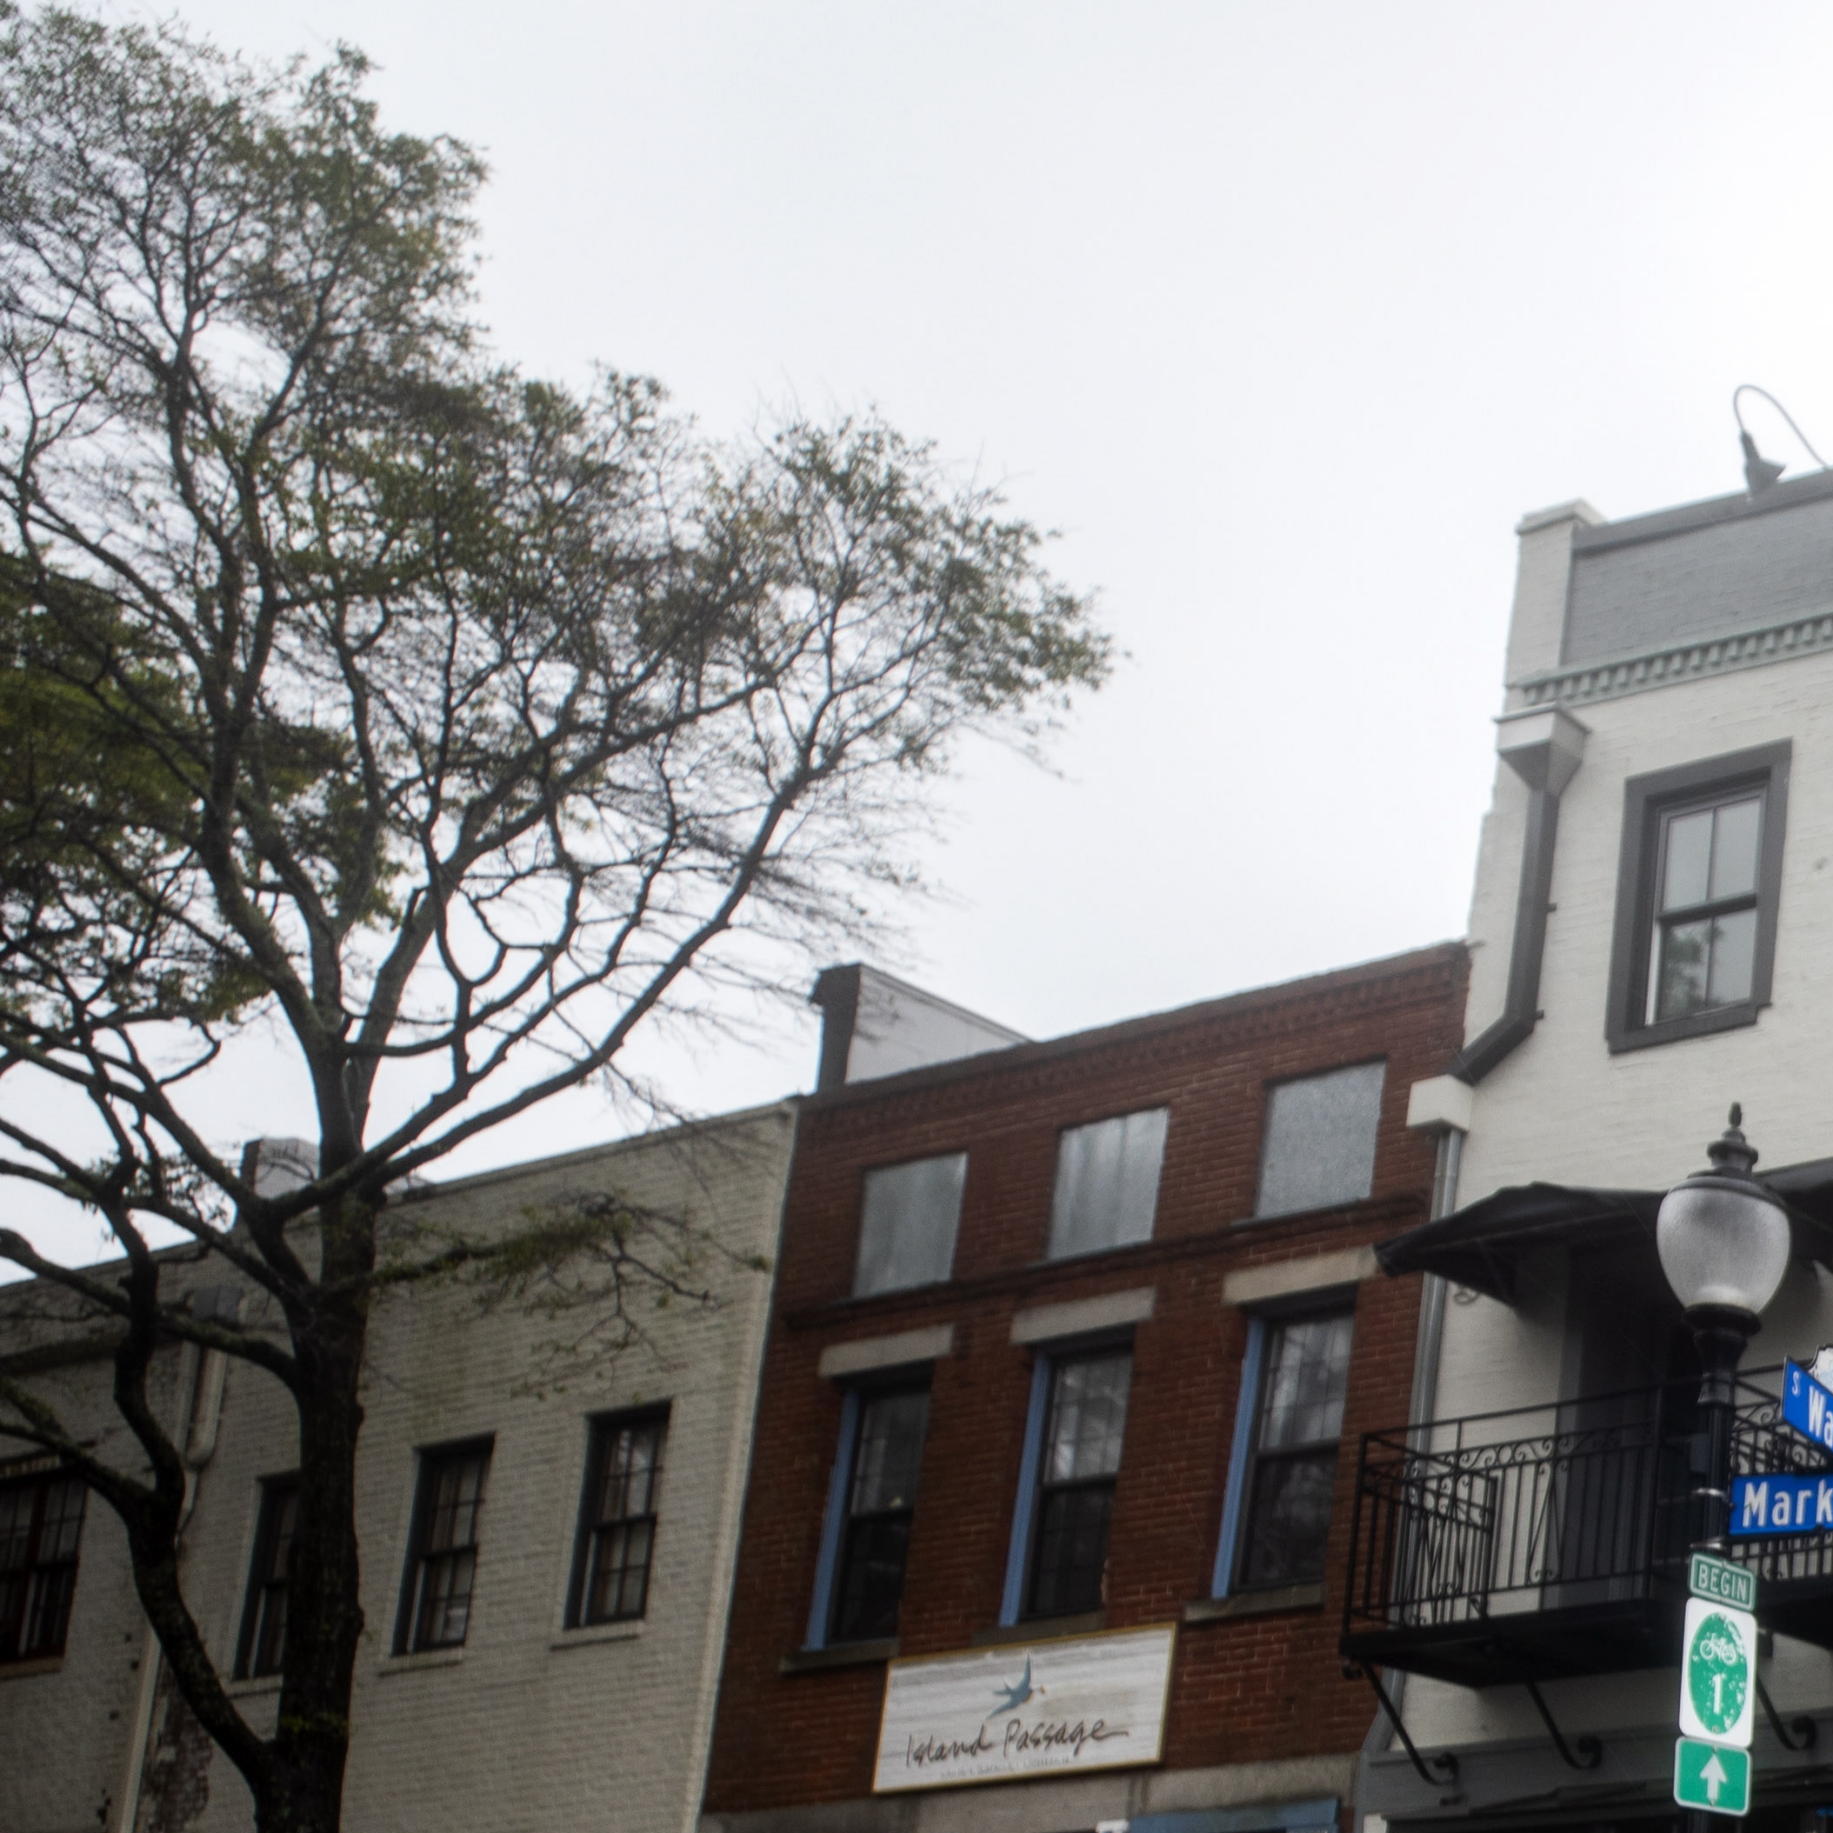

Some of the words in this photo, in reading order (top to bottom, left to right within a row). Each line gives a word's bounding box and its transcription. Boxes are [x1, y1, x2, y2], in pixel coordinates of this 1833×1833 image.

[1792, 1371, 1800, 1396] S
[1698, 1563, 1747, 1601] BEGIN
[1712, 1673, 1724, 1714] 1
[906, 1724, 993, 1768] Island
[1003, 1718, 1129, 1758] Passage
